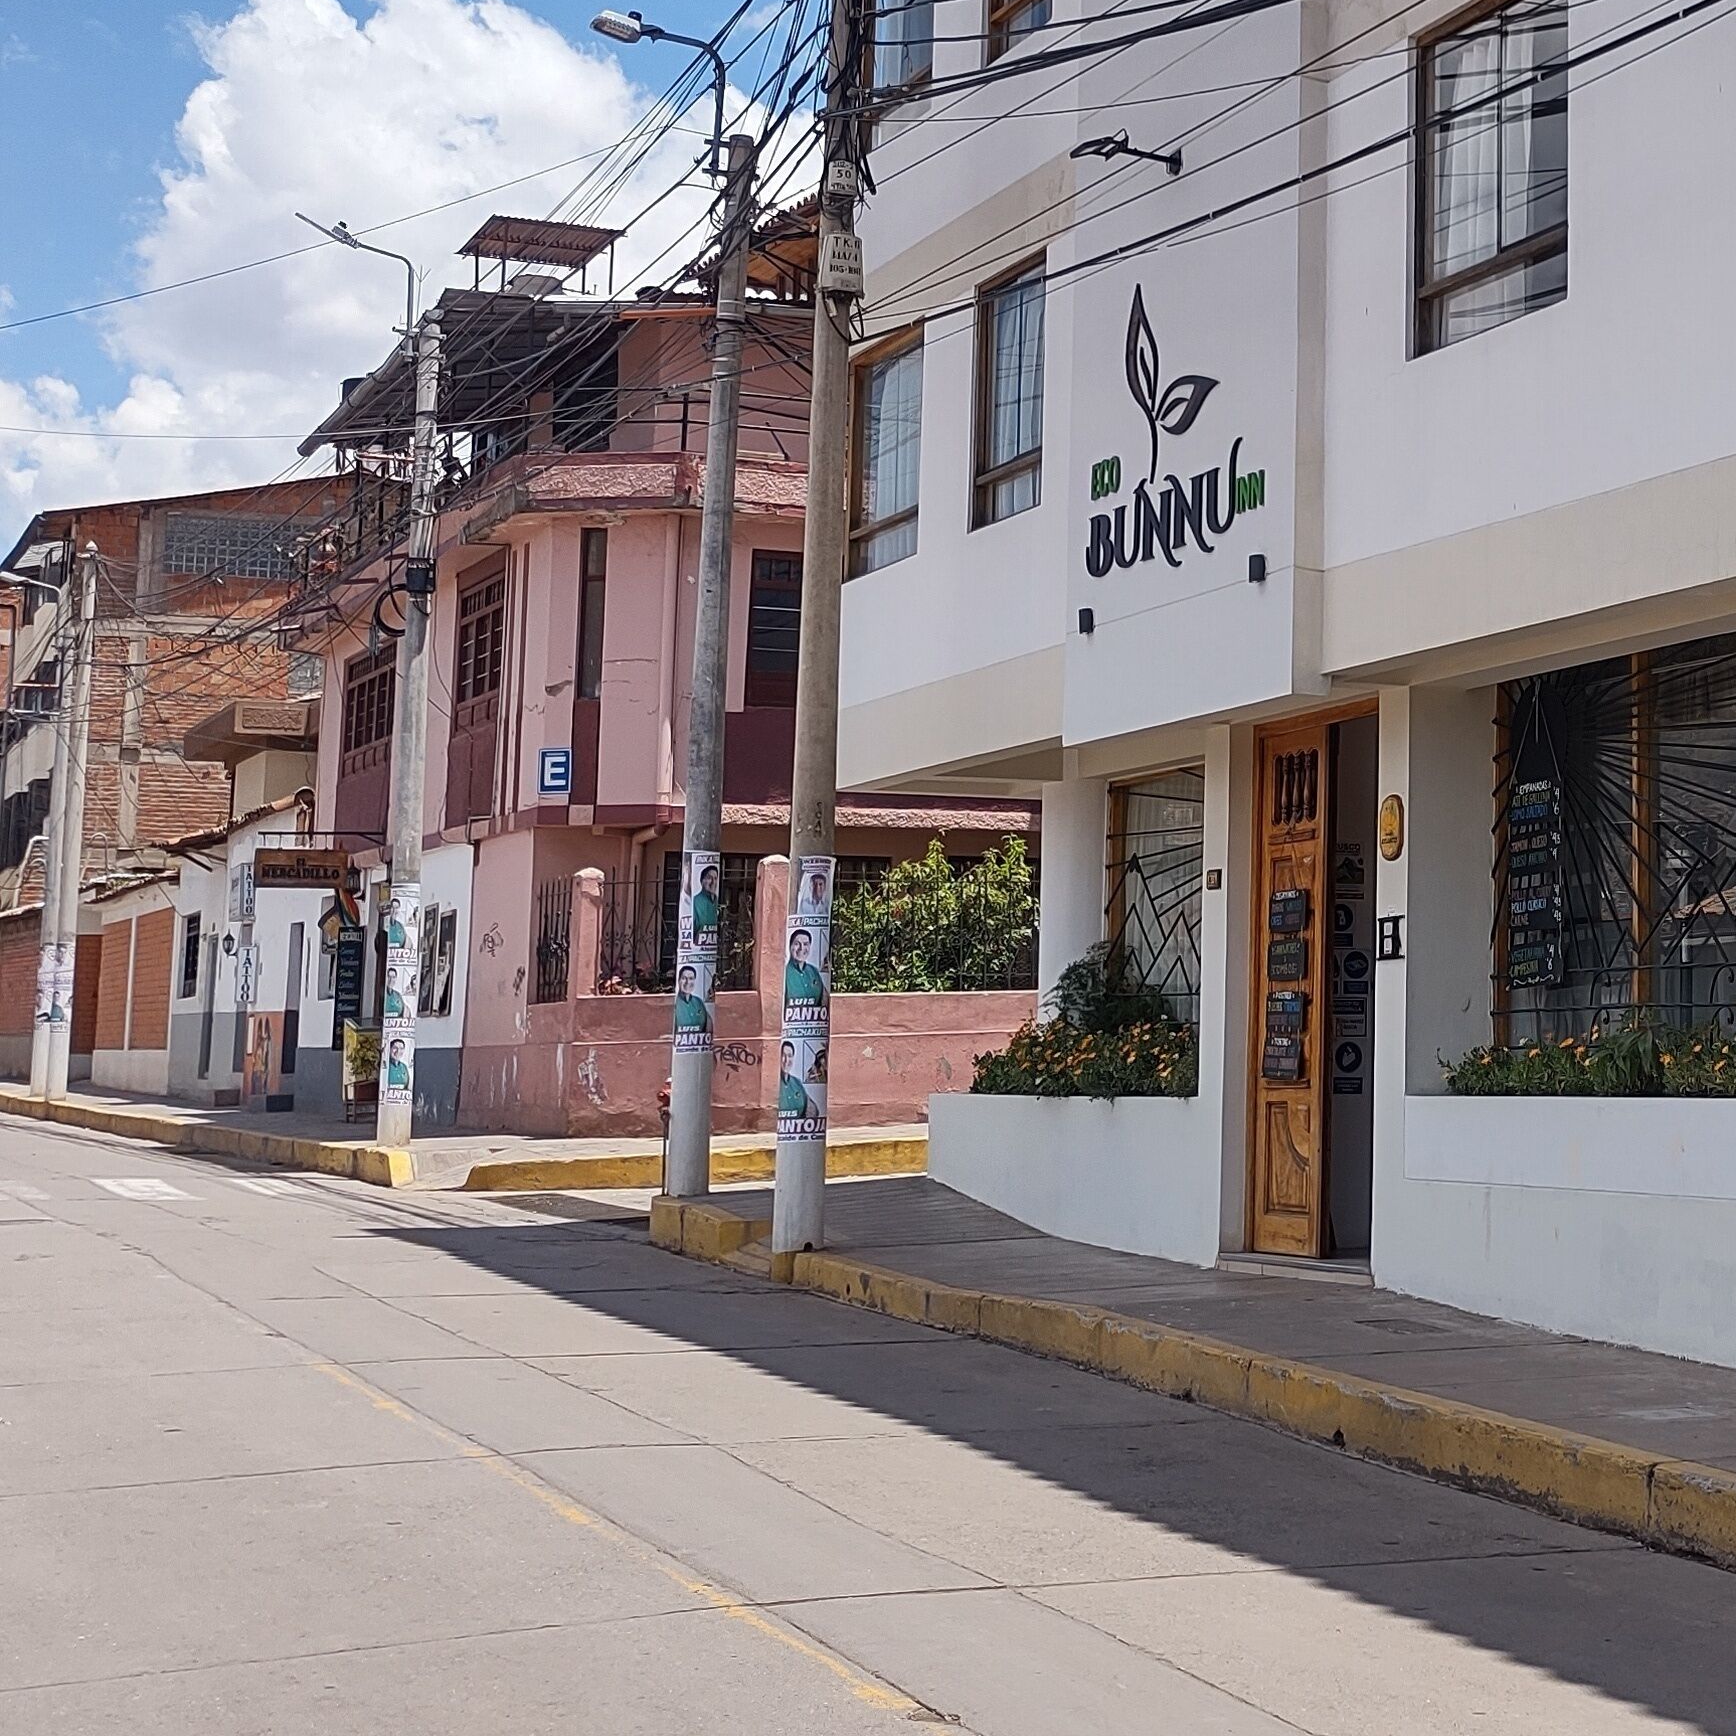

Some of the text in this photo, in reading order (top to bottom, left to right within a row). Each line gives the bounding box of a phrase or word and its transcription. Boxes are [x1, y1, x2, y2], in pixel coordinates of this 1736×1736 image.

[836, 169, 852, 179] 50
[1091, 456, 1121, 501] ECO
[1086, 436, 1266, 578] BUNNU INN
[544, 756, 566, 786] E
[262, 866, 340, 880] MERCADILLO
[789, 997, 815, 1006] LUIS
